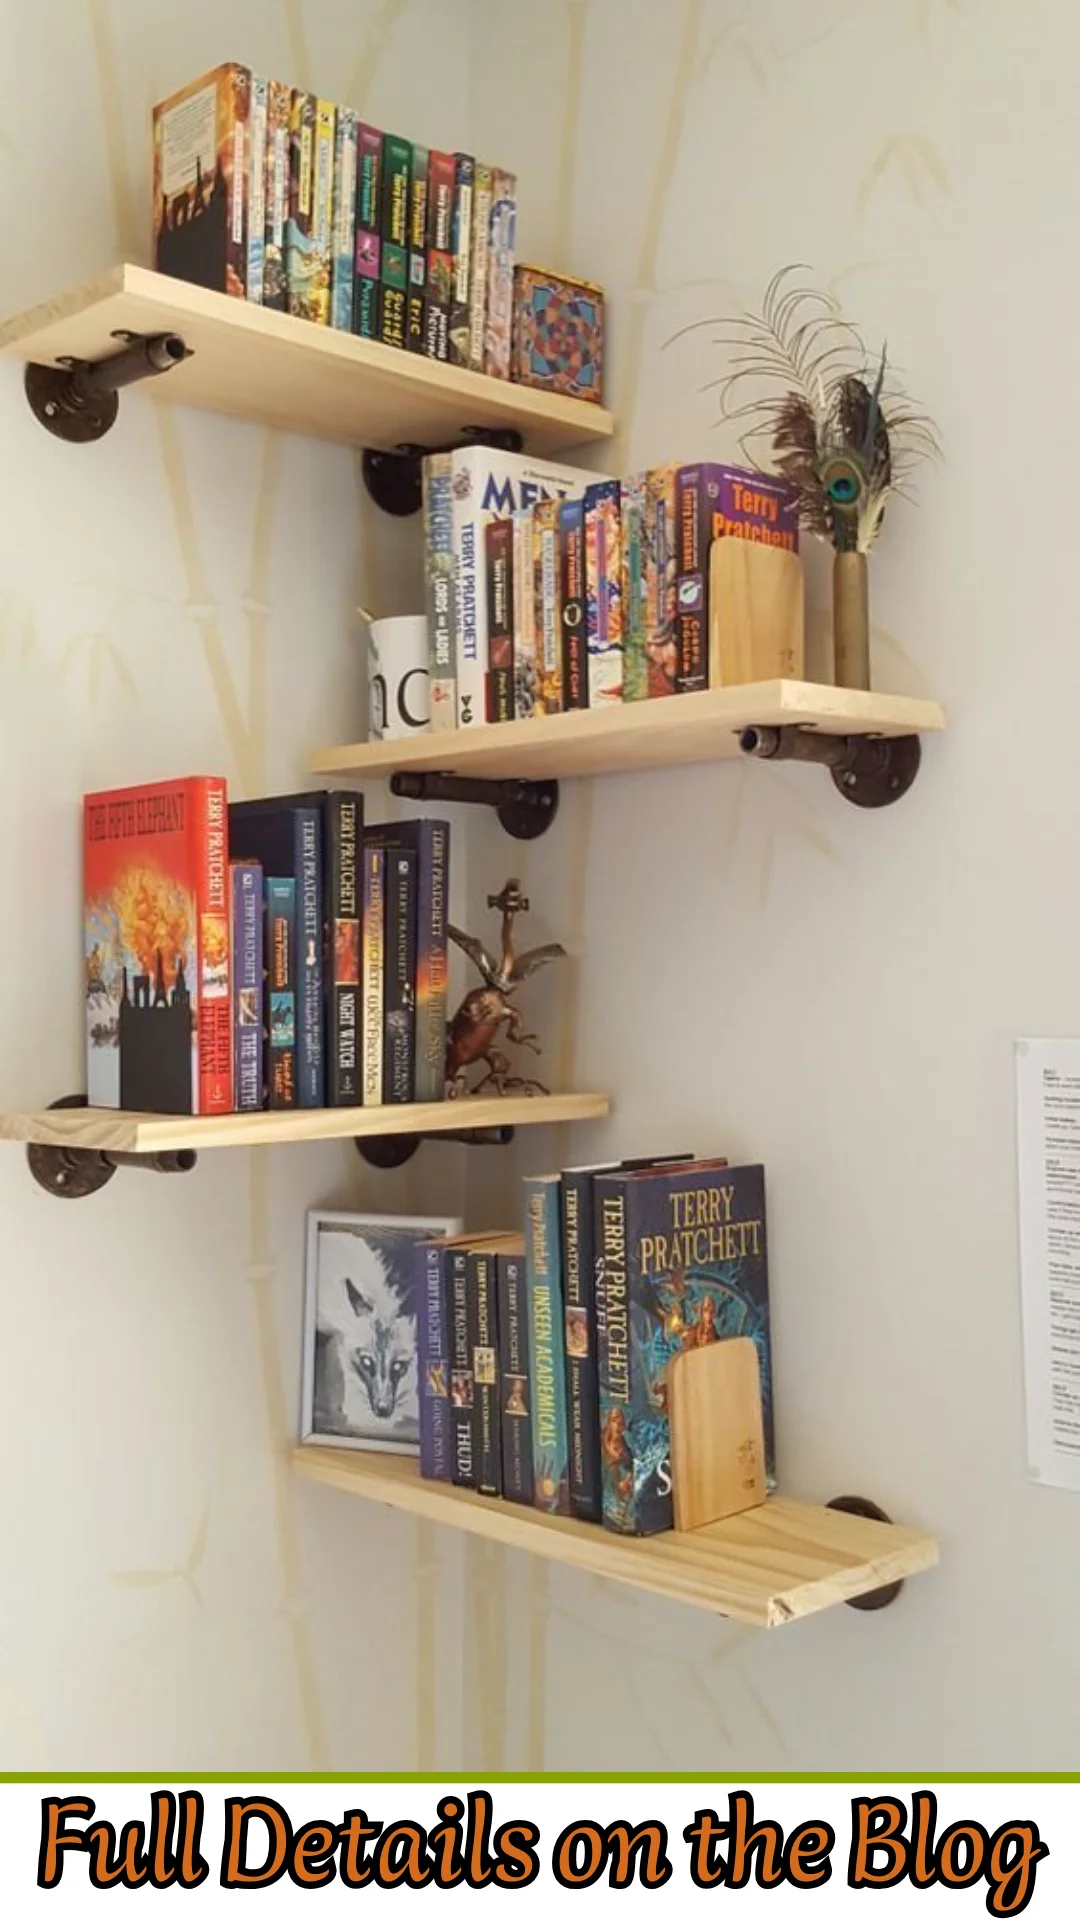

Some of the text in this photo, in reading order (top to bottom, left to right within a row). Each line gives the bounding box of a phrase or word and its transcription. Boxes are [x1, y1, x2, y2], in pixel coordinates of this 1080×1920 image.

[730, 483, 778, 522] Terry
[461, 521, 477, 660] TERRY PRATCHETT
[136, 793, 185, 836] ELEPHANT
[208, 789, 225, 907] TERRY PRATCHETT
[340, 802, 356, 915] TERRY PRATCHETT
[303, 820, 318, 936] TERRY PRATCHETT
[432, 828, 445, 937] TERRY PRATCHETT
[244, 892, 257, 985] TERRY PRATCHETT
[398, 918, 409, 981] PRATCHETT
[241, 1033, 258, 1106] THE TRUTH
[339, 992, 355, 1069] NIGHT WATCH
[566, 1188, 580, 1304] TERRY PRATCHETT
[640, 1220, 762, 1276] PRATCHETT
[669, 1185, 735, 1230] TERRY
[427, 1268, 442, 1357] TERRY PRATCHETT
[454, 1277, 469, 1366] TERRY PRATCHETT
[477, 1260, 490, 1346] TERRY PRATCHETT
[508, 1282, 519, 1372] TERRY PRATCHETT
[594, 1256, 608, 1337] SNUFF
[602, 1195, 630, 1405] TERRY PRATCHETT
[532, 1285, 558, 1449] UNSEEN ACADEMICALS
[456, 1420, 473, 1478] THUD!
